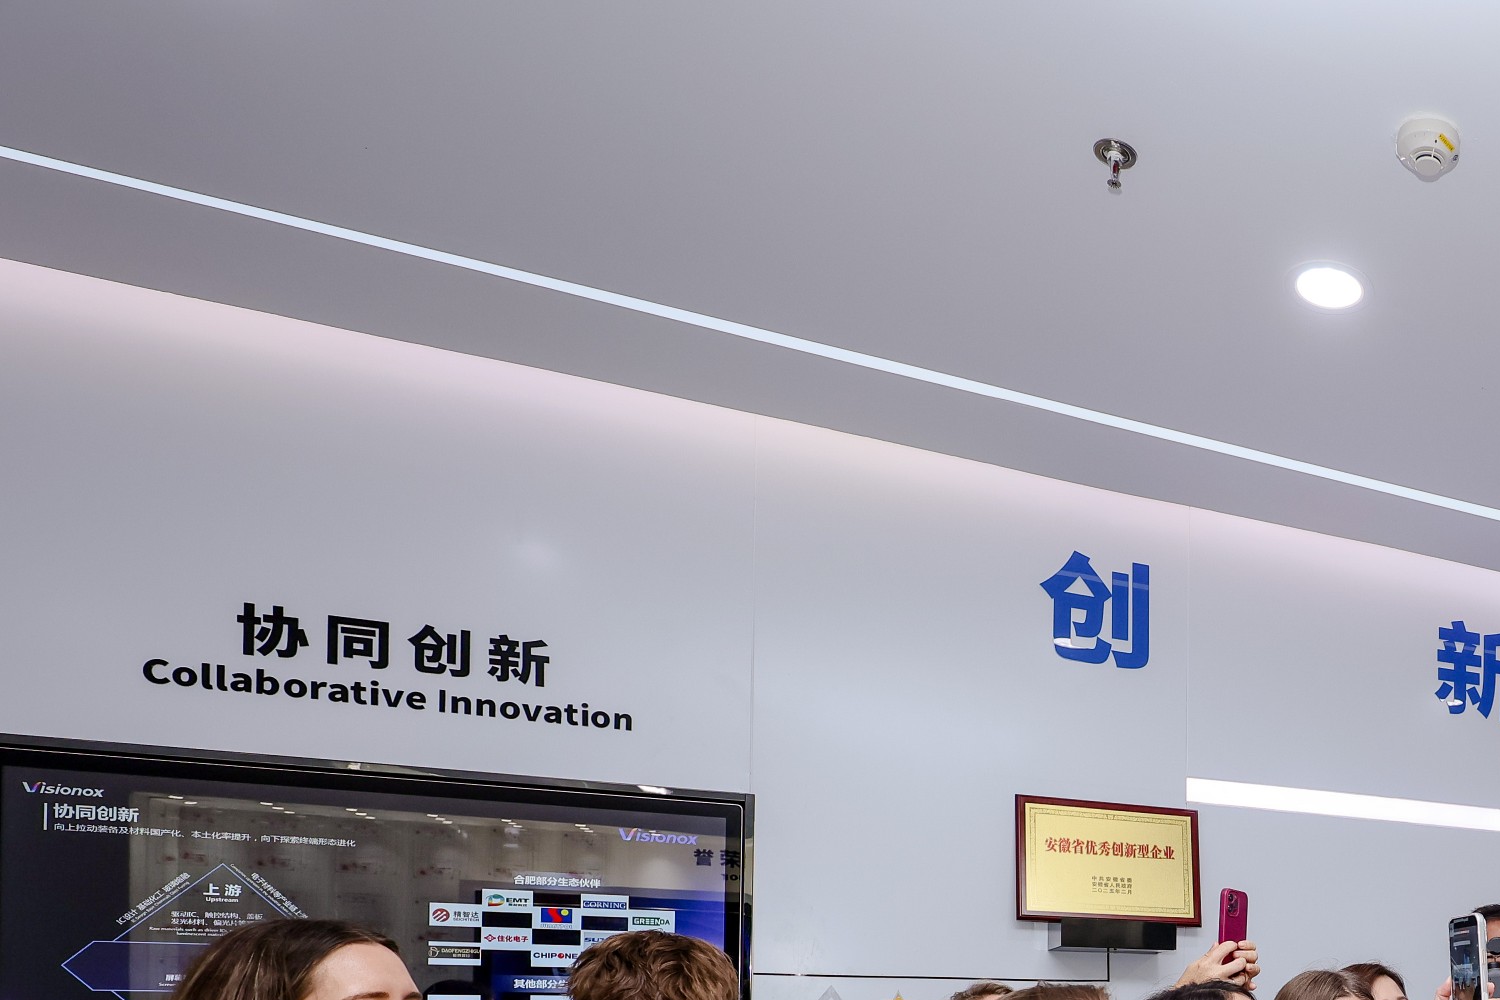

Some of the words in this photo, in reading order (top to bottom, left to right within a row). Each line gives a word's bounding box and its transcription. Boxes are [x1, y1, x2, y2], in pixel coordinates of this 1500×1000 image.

[236, 602, 550, 687] 协同创新
[142, 657, 428, 712] Collaborative
[437, 689, 634, 733] Innovation
[22, 781, 104, 798] Visionox
[53, 802, 139, 823] 协同创新
[618, 827, 699, 845] Visionox
[1045, 837, 1176, 860] 安徽省优秀创新型企业
[203, 883, 242, 897] 上游
[513, 874, 601, 889] 合肥部分生态伙伴
[205, 896, 239, 904] Upstream
[583, 901, 627, 909] CORNING
